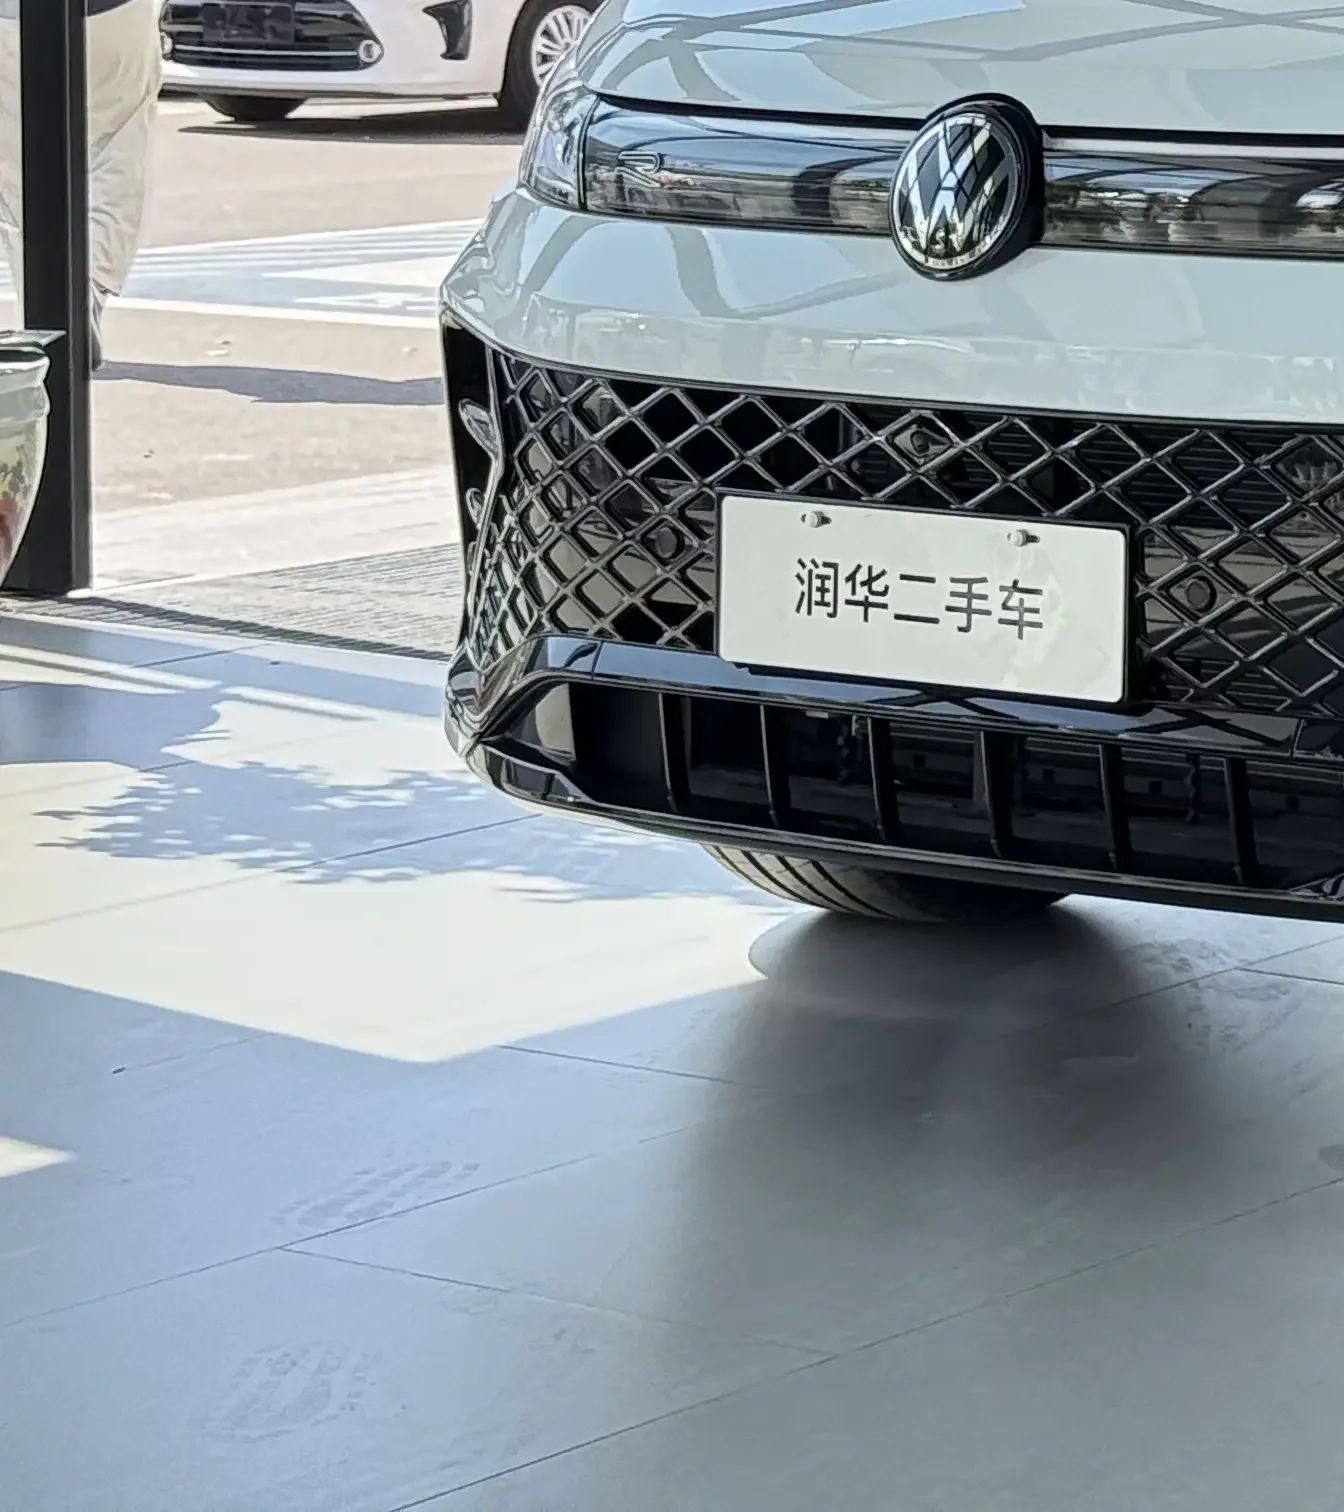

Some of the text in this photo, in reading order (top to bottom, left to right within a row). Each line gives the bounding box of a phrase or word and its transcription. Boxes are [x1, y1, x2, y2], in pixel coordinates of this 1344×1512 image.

[794, 557, 1043, 640] 润华二手车
